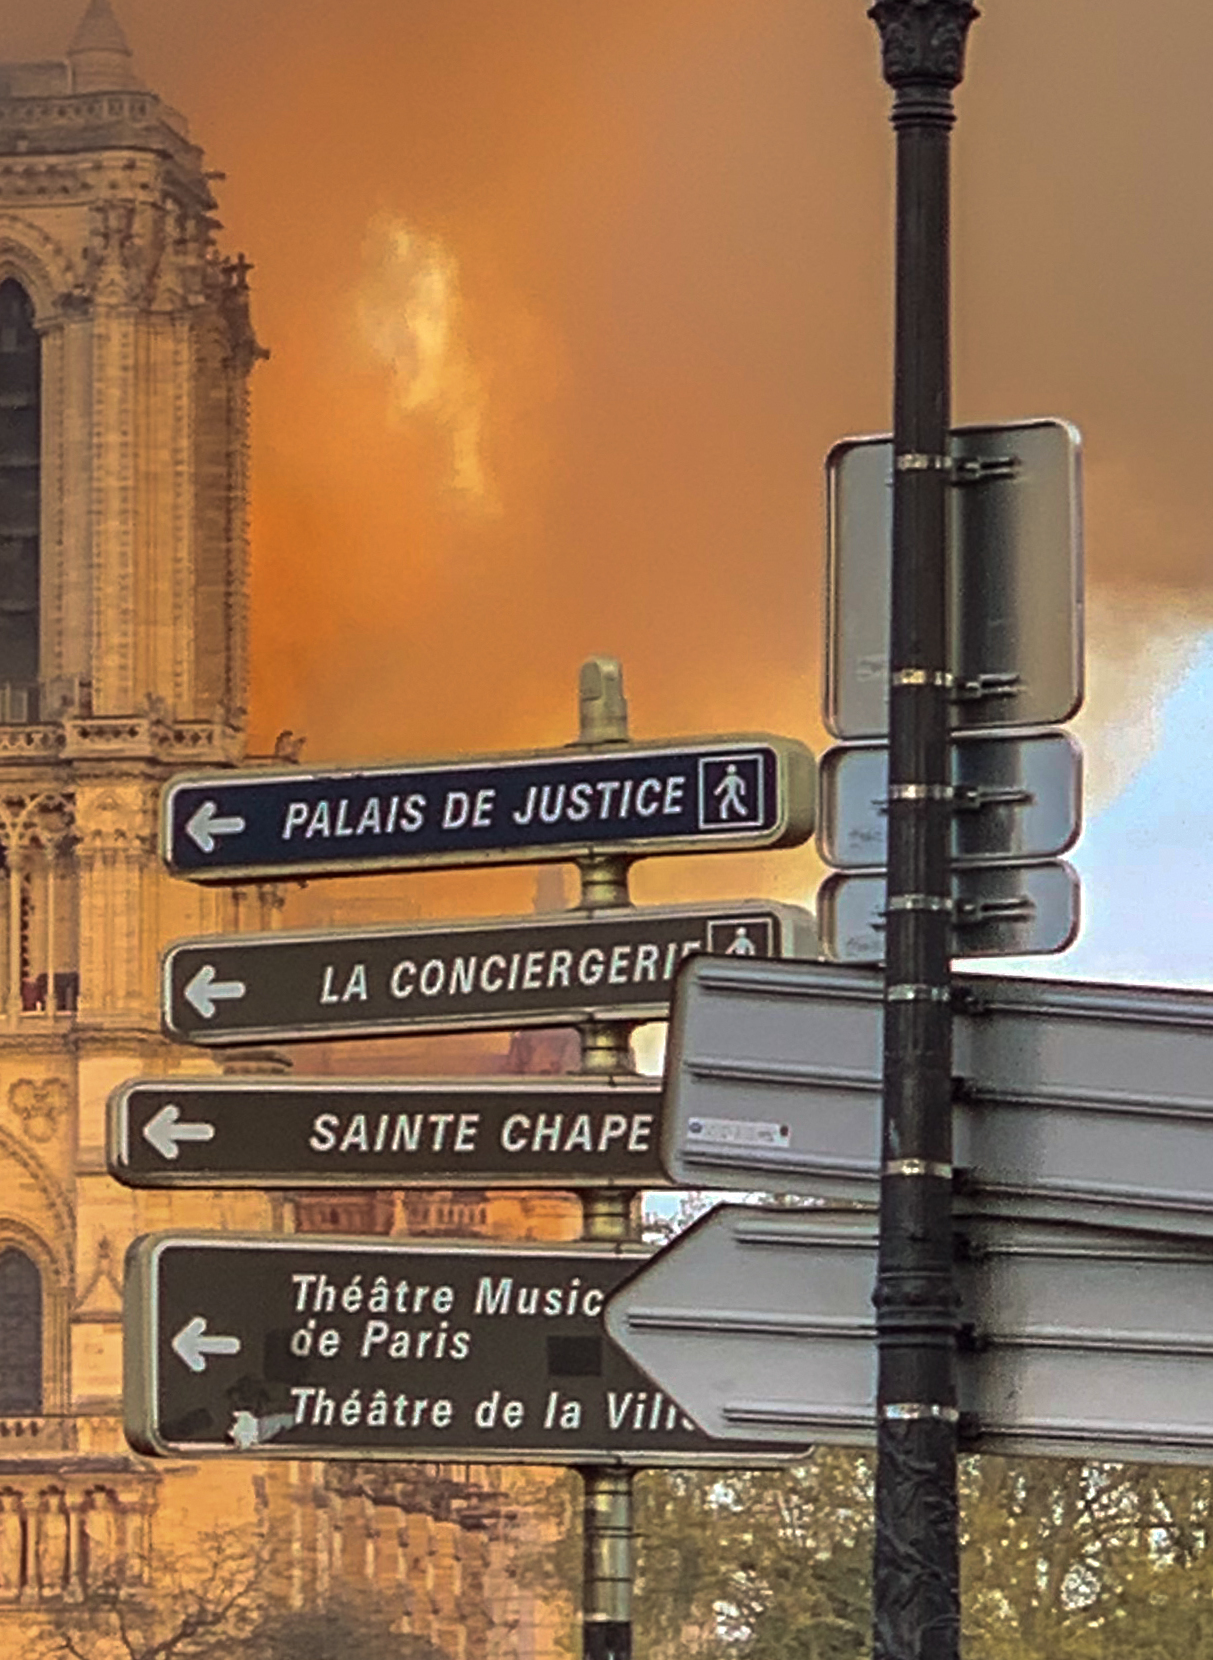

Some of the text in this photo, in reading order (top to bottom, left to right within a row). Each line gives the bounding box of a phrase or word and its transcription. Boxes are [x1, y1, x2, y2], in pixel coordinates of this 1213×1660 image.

[282, 776, 686, 839] PALAIS DE JUSTICE
[320, 965, 369, 1004] LA
[309, 1113, 480, 1152] SAINTE
[501, 1113, 653, 1152] CHAPE
[291, 1274, 605, 1317] Théâtre Music
[290, 1319, 471, 1360] de Paris
[290, 1387, 695, 1431] Théâtre de la Vill
